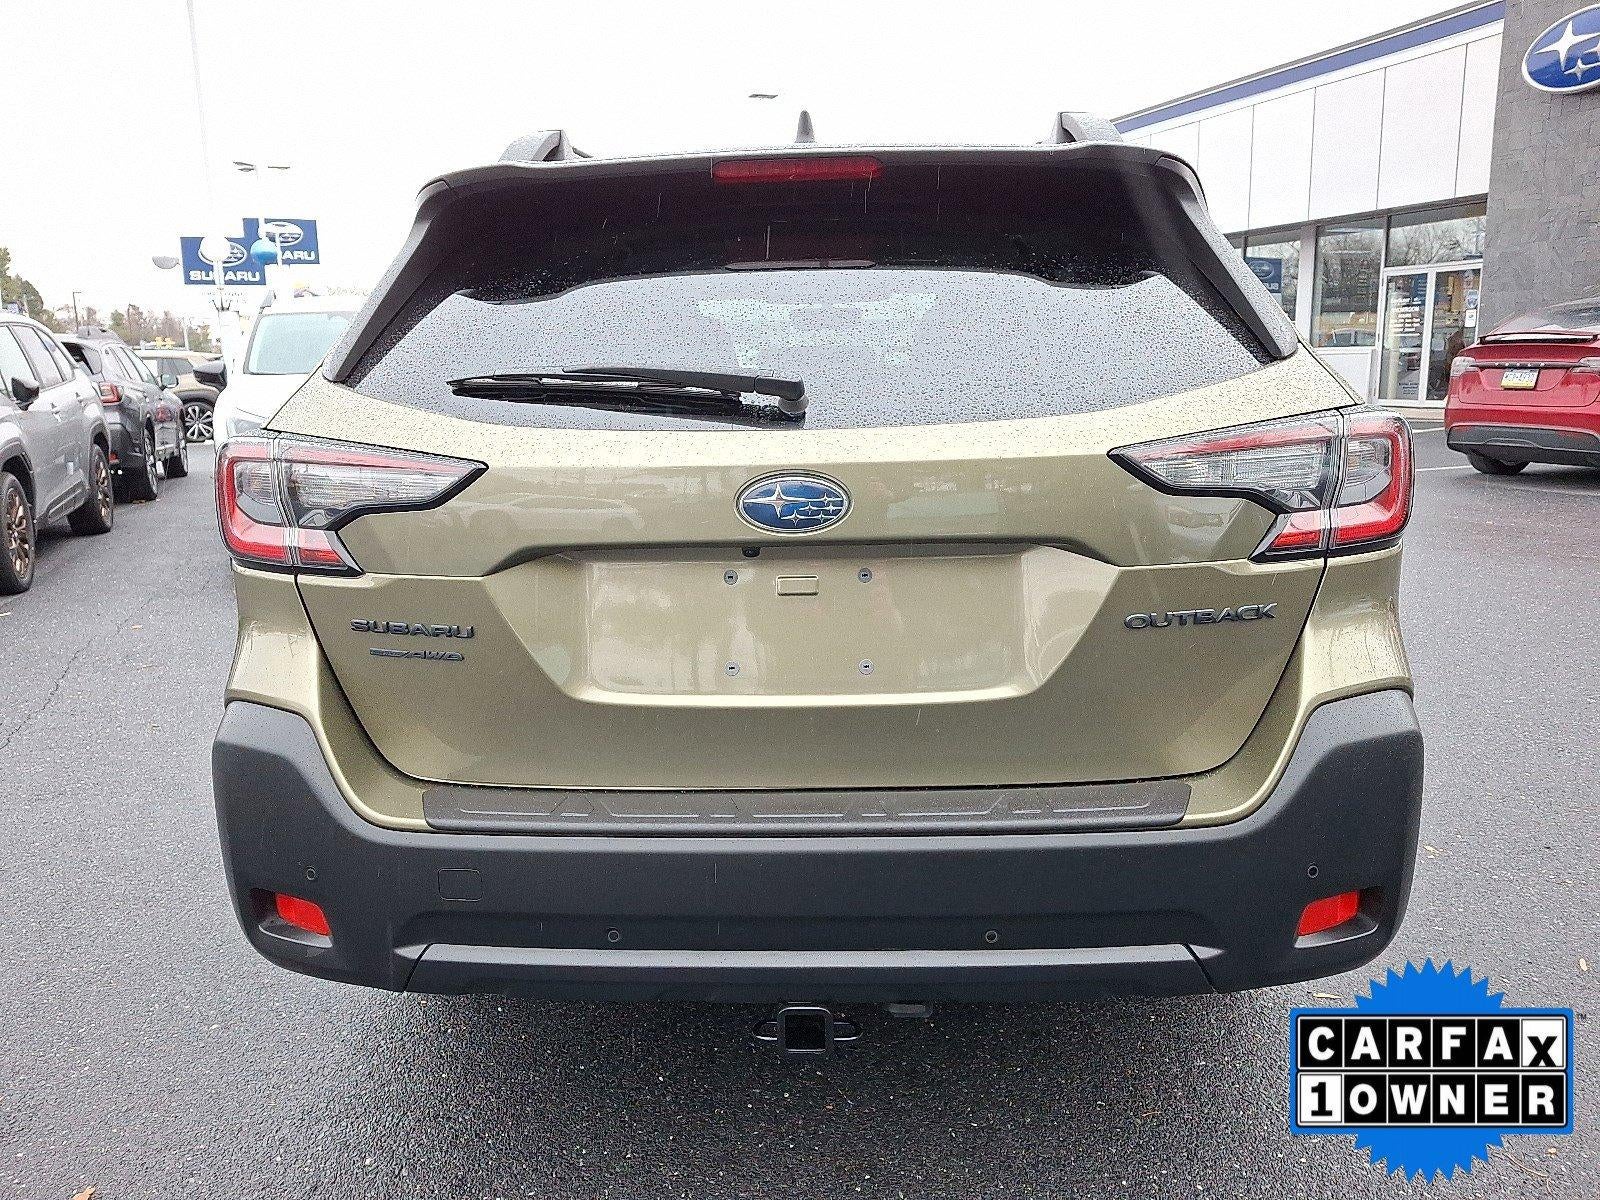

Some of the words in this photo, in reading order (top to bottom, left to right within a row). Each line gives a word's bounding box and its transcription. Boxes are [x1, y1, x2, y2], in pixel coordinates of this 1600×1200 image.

[189, 270, 260, 282] SUARU
[1124, 603, 1278, 629] OUTBACK
[350, 618, 475, 639] SUBARU
[404, 650, 464, 661] AWD
